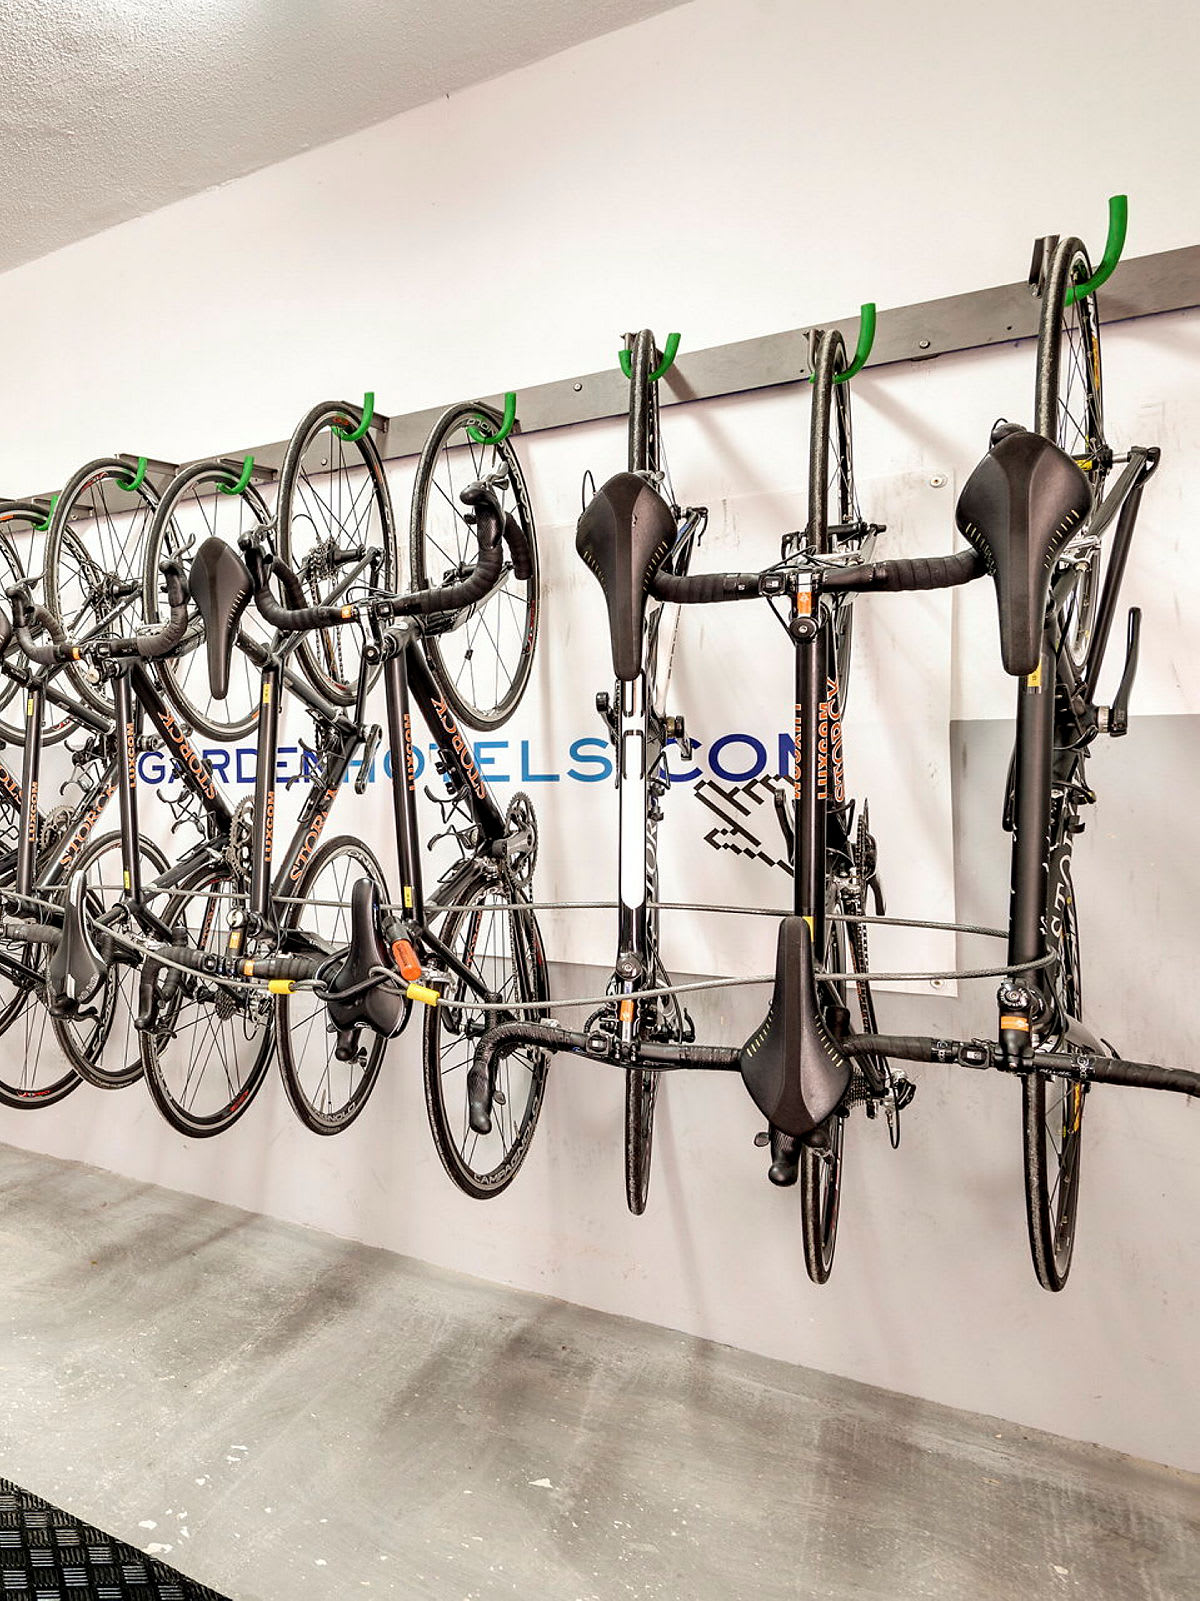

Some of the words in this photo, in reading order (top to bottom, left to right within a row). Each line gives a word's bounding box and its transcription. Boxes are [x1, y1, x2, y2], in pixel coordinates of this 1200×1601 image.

[126, 723, 136, 788] LUXCOM
[157, 708, 217, 800] STORCK
[403, 713, 415, 791] LUXCOM
[430, 696, 487, 800] STORCK
[817, 702, 829, 800] LUXCOM
[28, 781, 39, 842] LUXCOM
[59, 779, 117, 865] STORCK
[264, 791, 275, 862] LUXCOM
[289, 787, 338, 881] STORK
